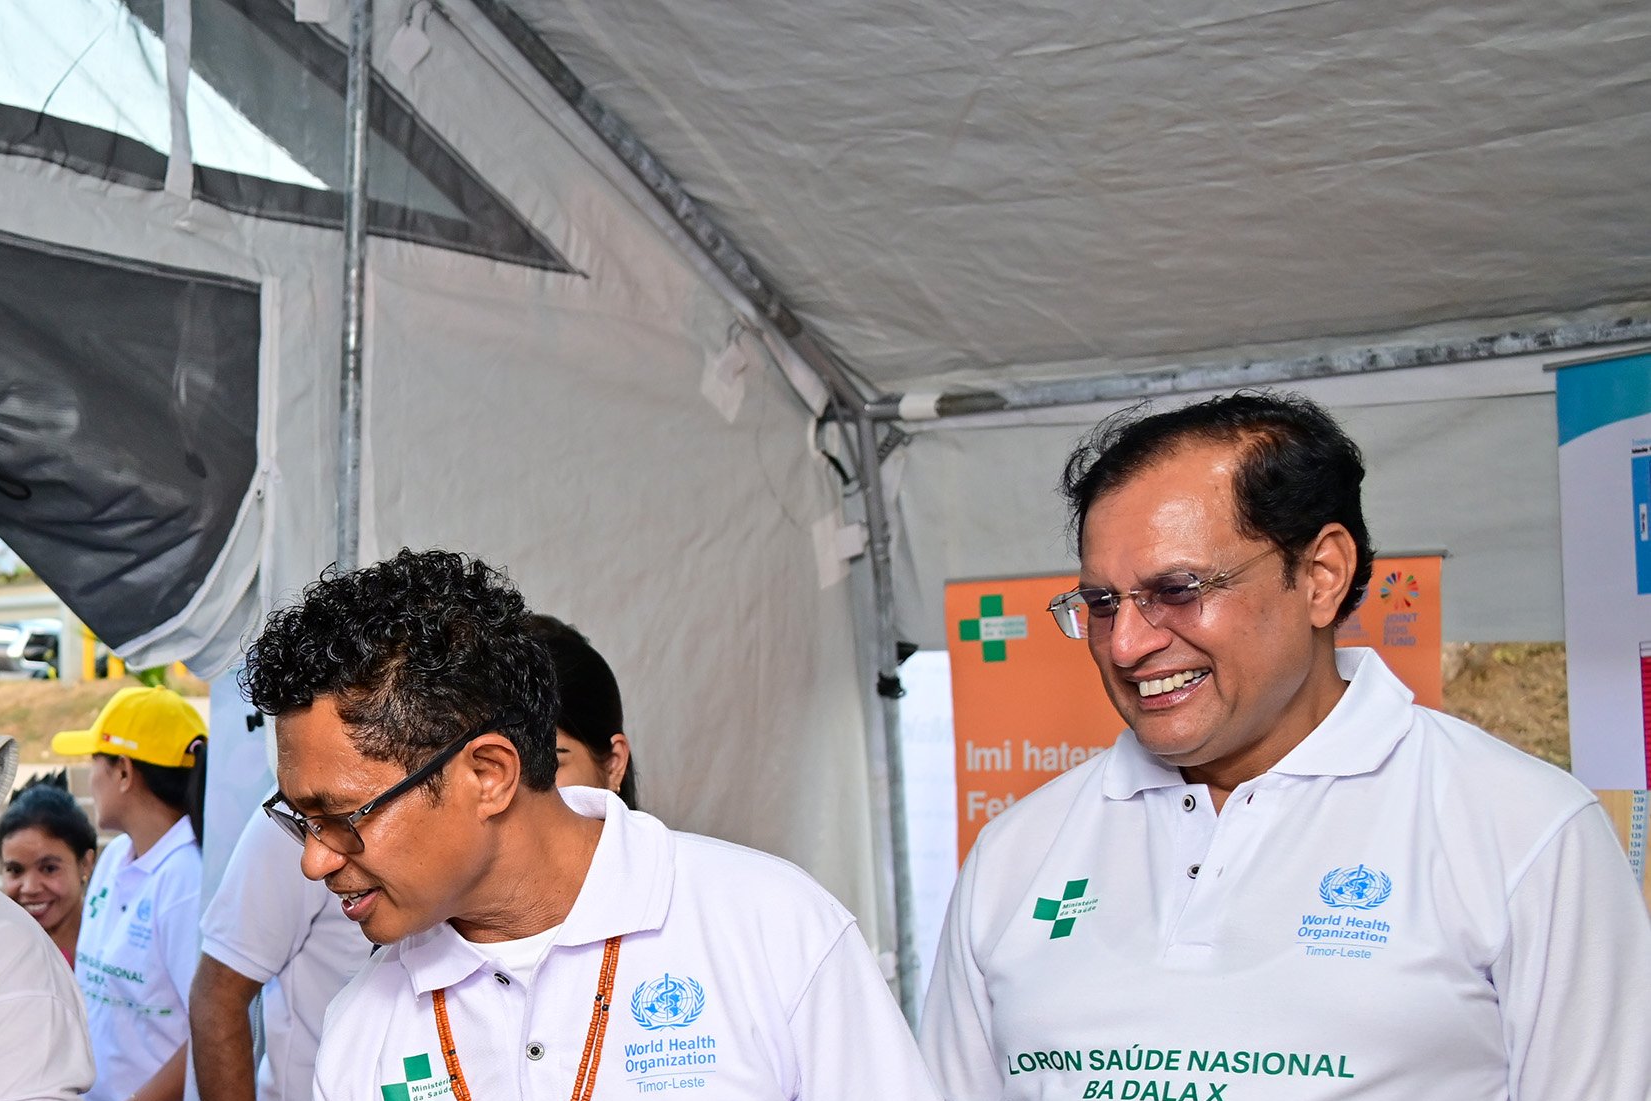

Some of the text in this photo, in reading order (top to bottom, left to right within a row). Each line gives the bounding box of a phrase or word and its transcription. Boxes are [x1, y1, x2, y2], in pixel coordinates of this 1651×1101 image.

[965, 739, 1011, 773] Imi
[1302, 915, 1390, 932] World Health
[1298, 927, 1387, 943] Organization
[1306, 946, 1371, 959] Timor-Leste
[624, 1035, 716, 1057] World Health
[625, 1052, 717, 1074] Organization
[1007, 1044, 1355, 1078] LORON SAÚDE NASIONAL
[636, 1076, 705, 1093] Timor-Leste
[1082, 1079, 1115, 1099] BA
[413, 1094, 424, 1101] da
